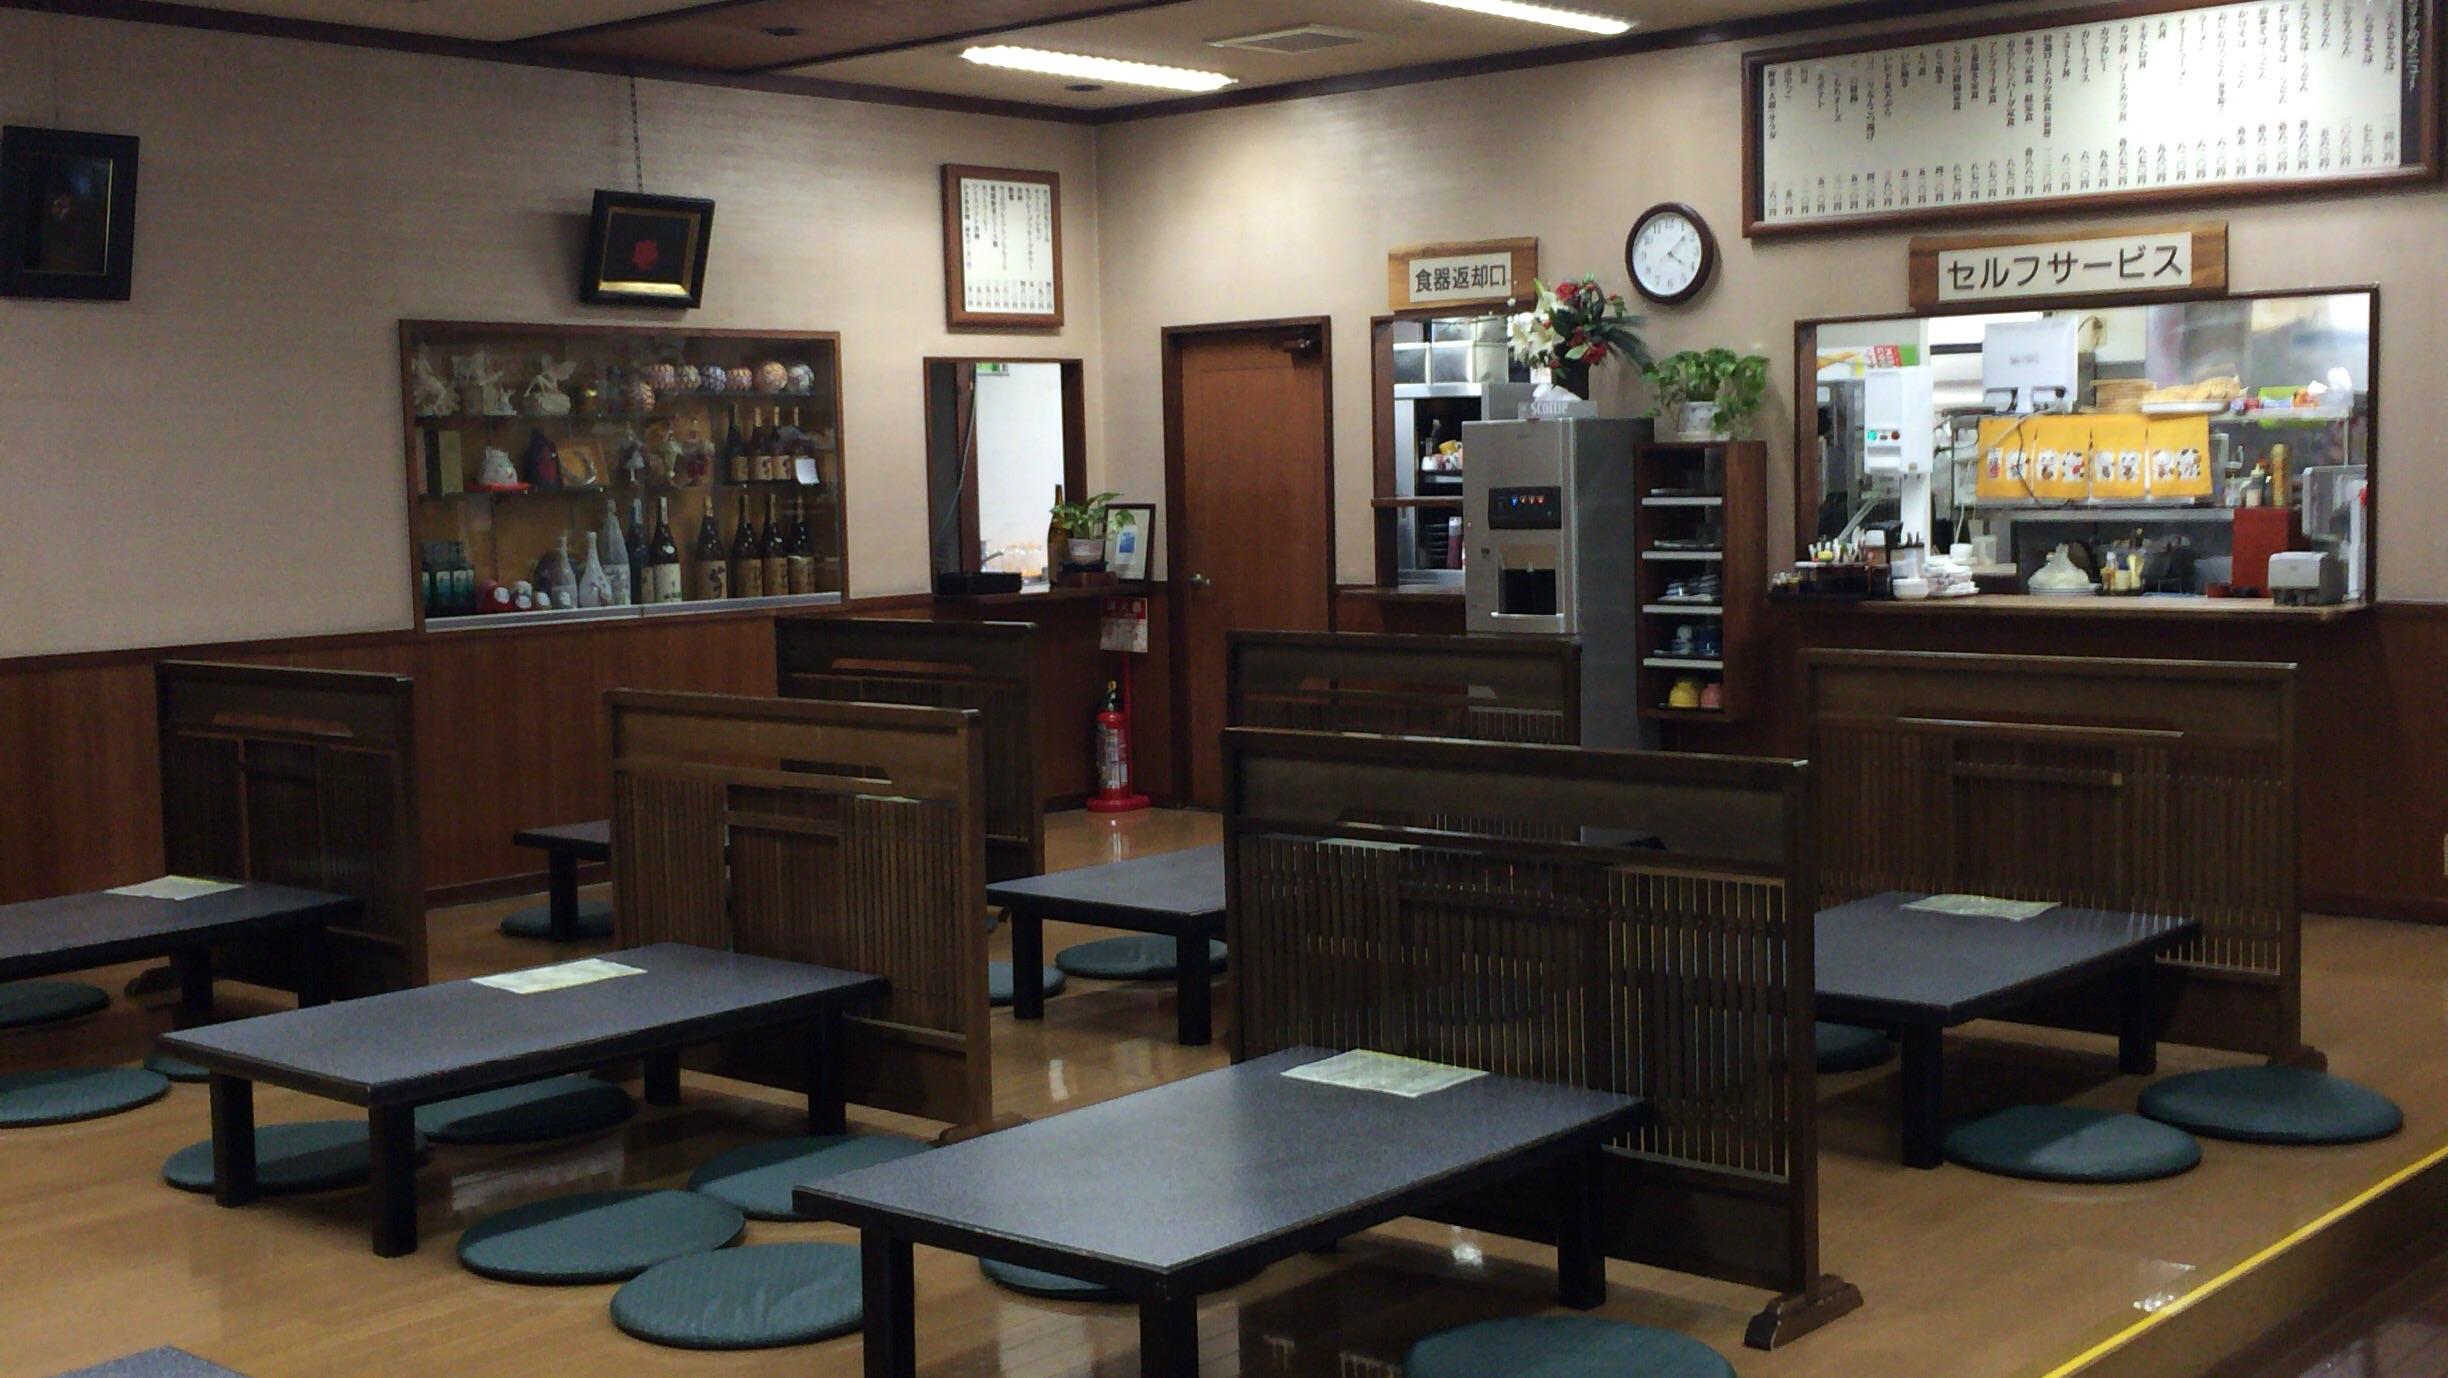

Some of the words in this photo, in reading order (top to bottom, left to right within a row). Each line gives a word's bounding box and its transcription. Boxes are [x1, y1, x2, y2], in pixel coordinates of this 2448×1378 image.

[1415, 264, 1507, 293] 食器返却口
[1947, 244, 2184, 291] セルフサービス
